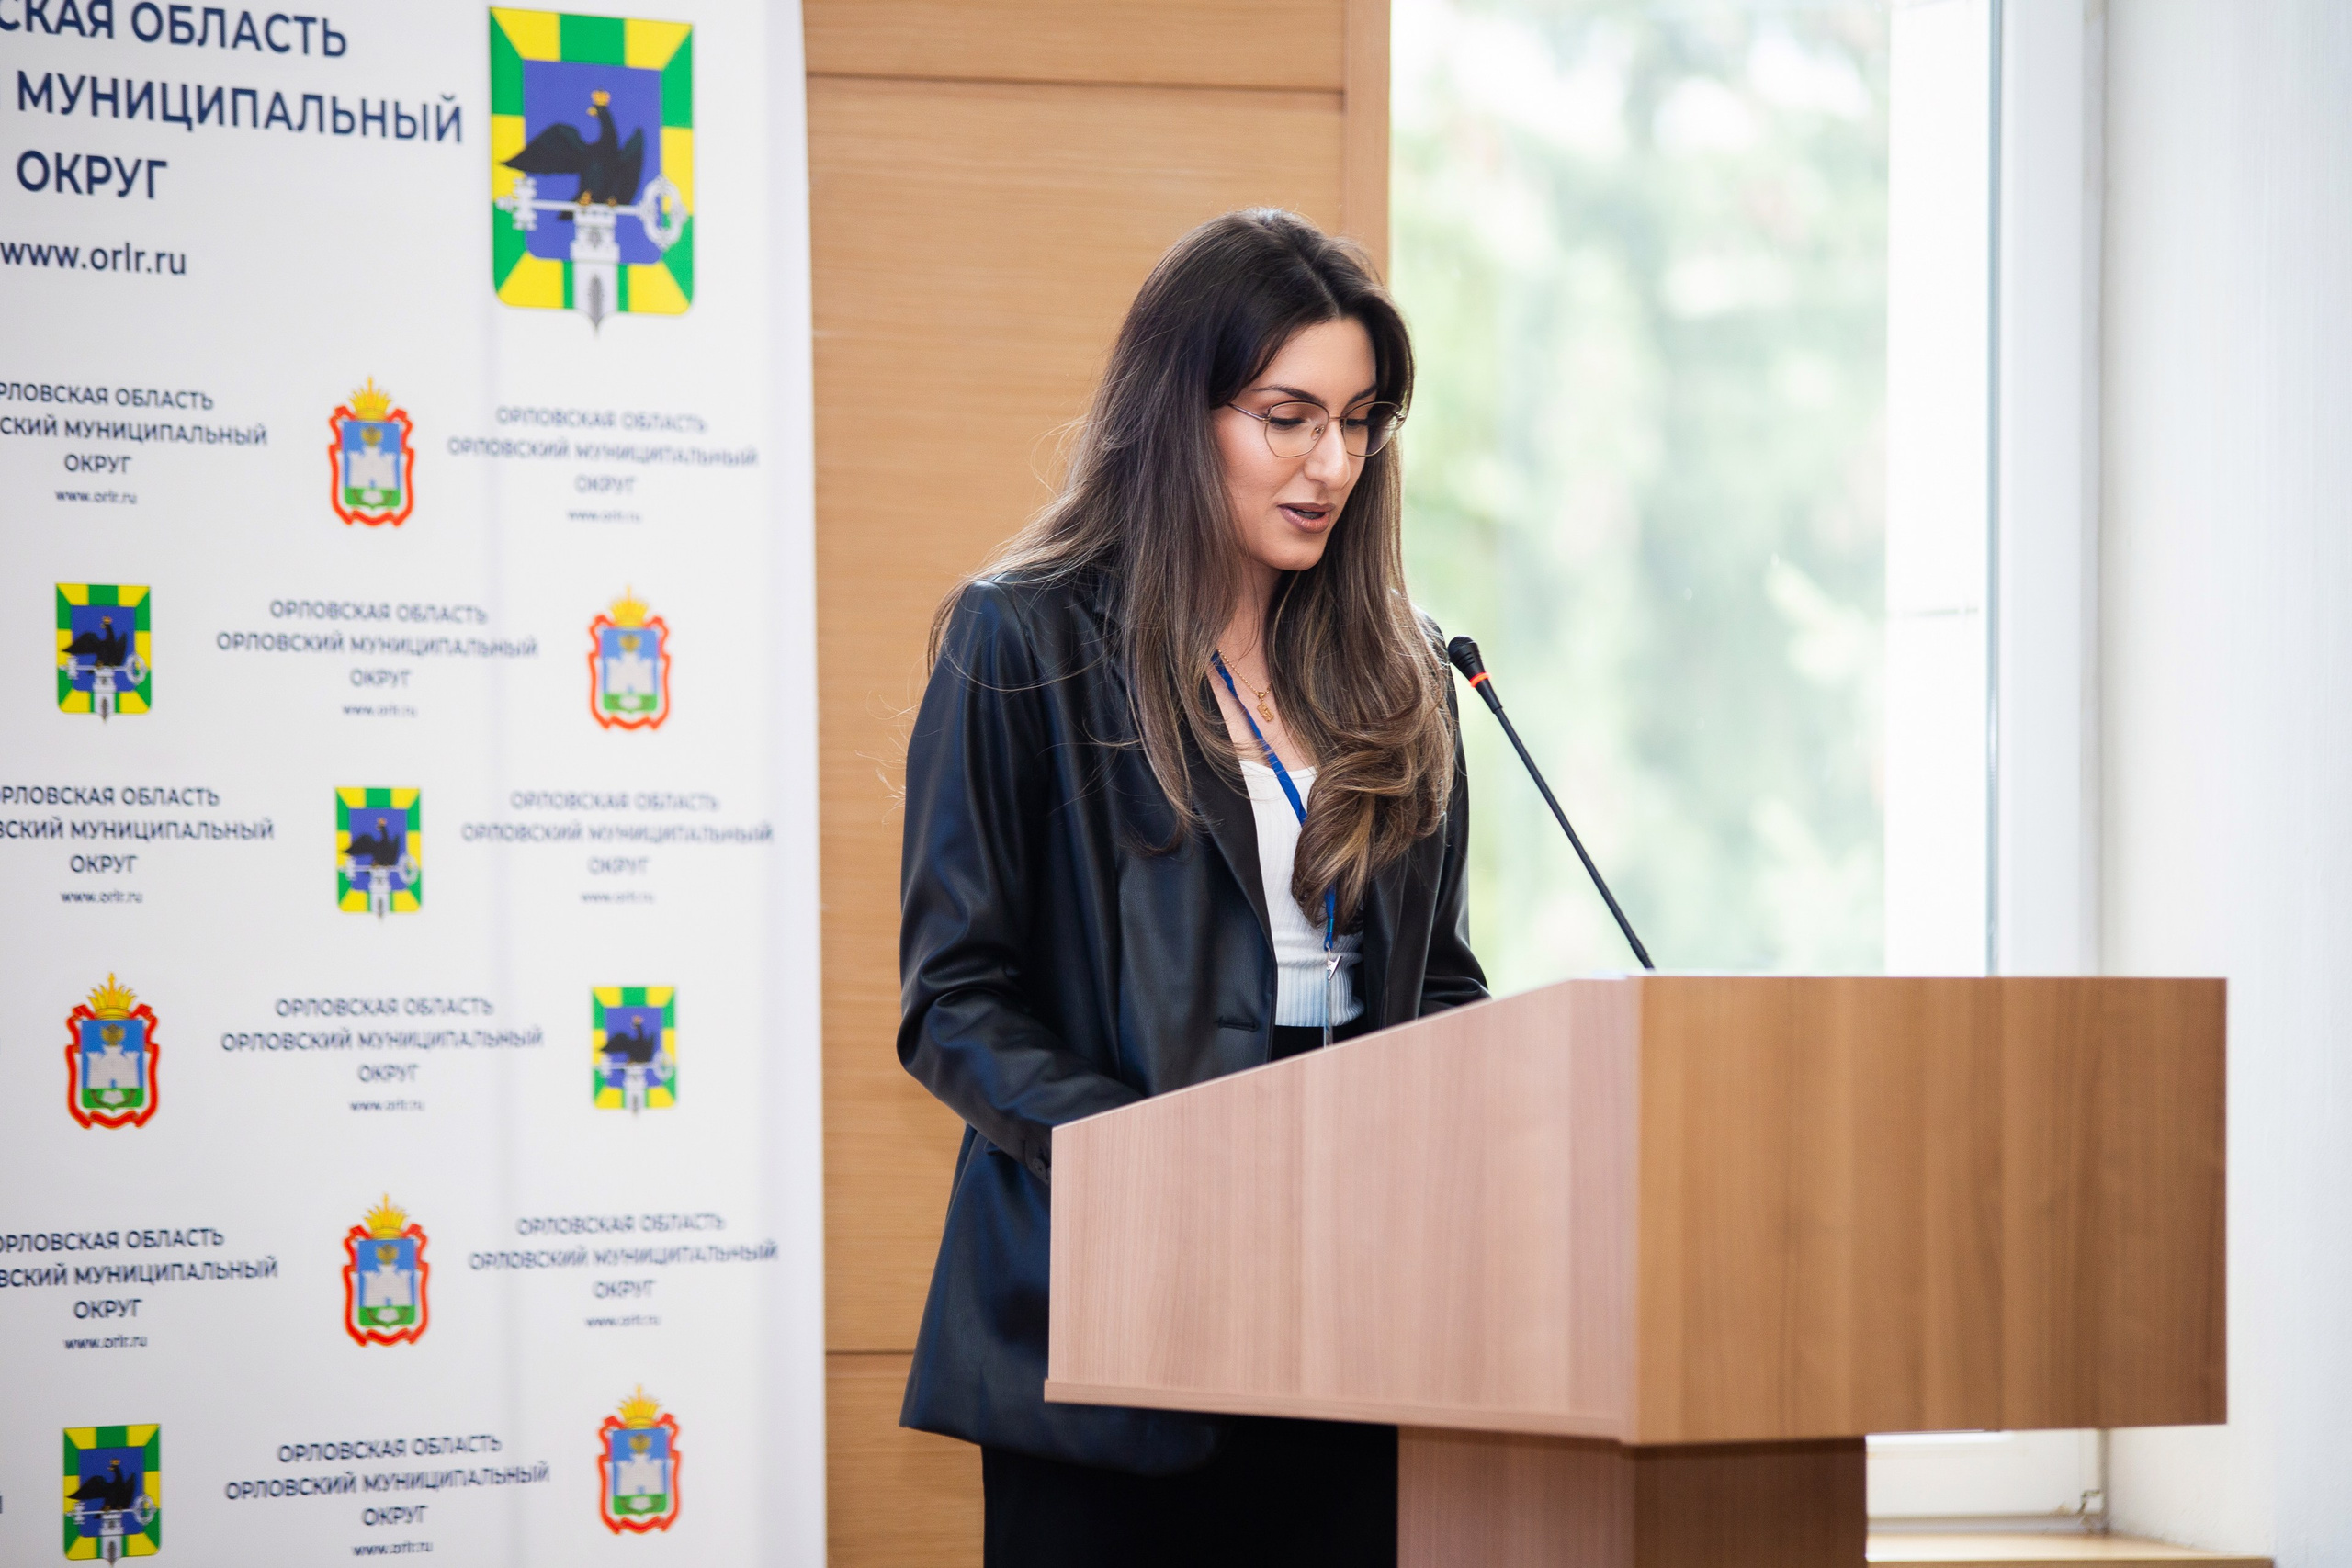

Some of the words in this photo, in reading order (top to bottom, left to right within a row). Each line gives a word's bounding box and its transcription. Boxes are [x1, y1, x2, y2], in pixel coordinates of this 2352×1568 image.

[130, 1, 346, 59] ОБЛАСТЬ
[17, 70, 462, 143] МУНИЦИПАЛЬНЫЙ
[17, 150, 167, 200] ОКРУГ
[0, 242, 187, 276] www.orlr.ru
[115, 388, 214, 411] ОБЛАСТЬ
[63, 419, 267, 446] МУНИЦИПАЛЬНЫЙ
[63, 453, 131, 474] ОКРУГ
[121, 785, 220, 807] ОБЛАСТЬ
[0, 817, 64, 840] СКИЙ
[69, 816, 275, 842] МУНИЦИПАЛЬНЫЙ
[70, 853, 138, 874] ОКРУГ
[0, 1230, 120, 1254] РЛОВСКАЯ
[126, 1227, 224, 1249] ОБЛАСТЬ
[74, 1255, 277, 1286] МУНИЦИПАЛЬНЫЙ
[73, 1297, 142, 1320] ОКРУГ
